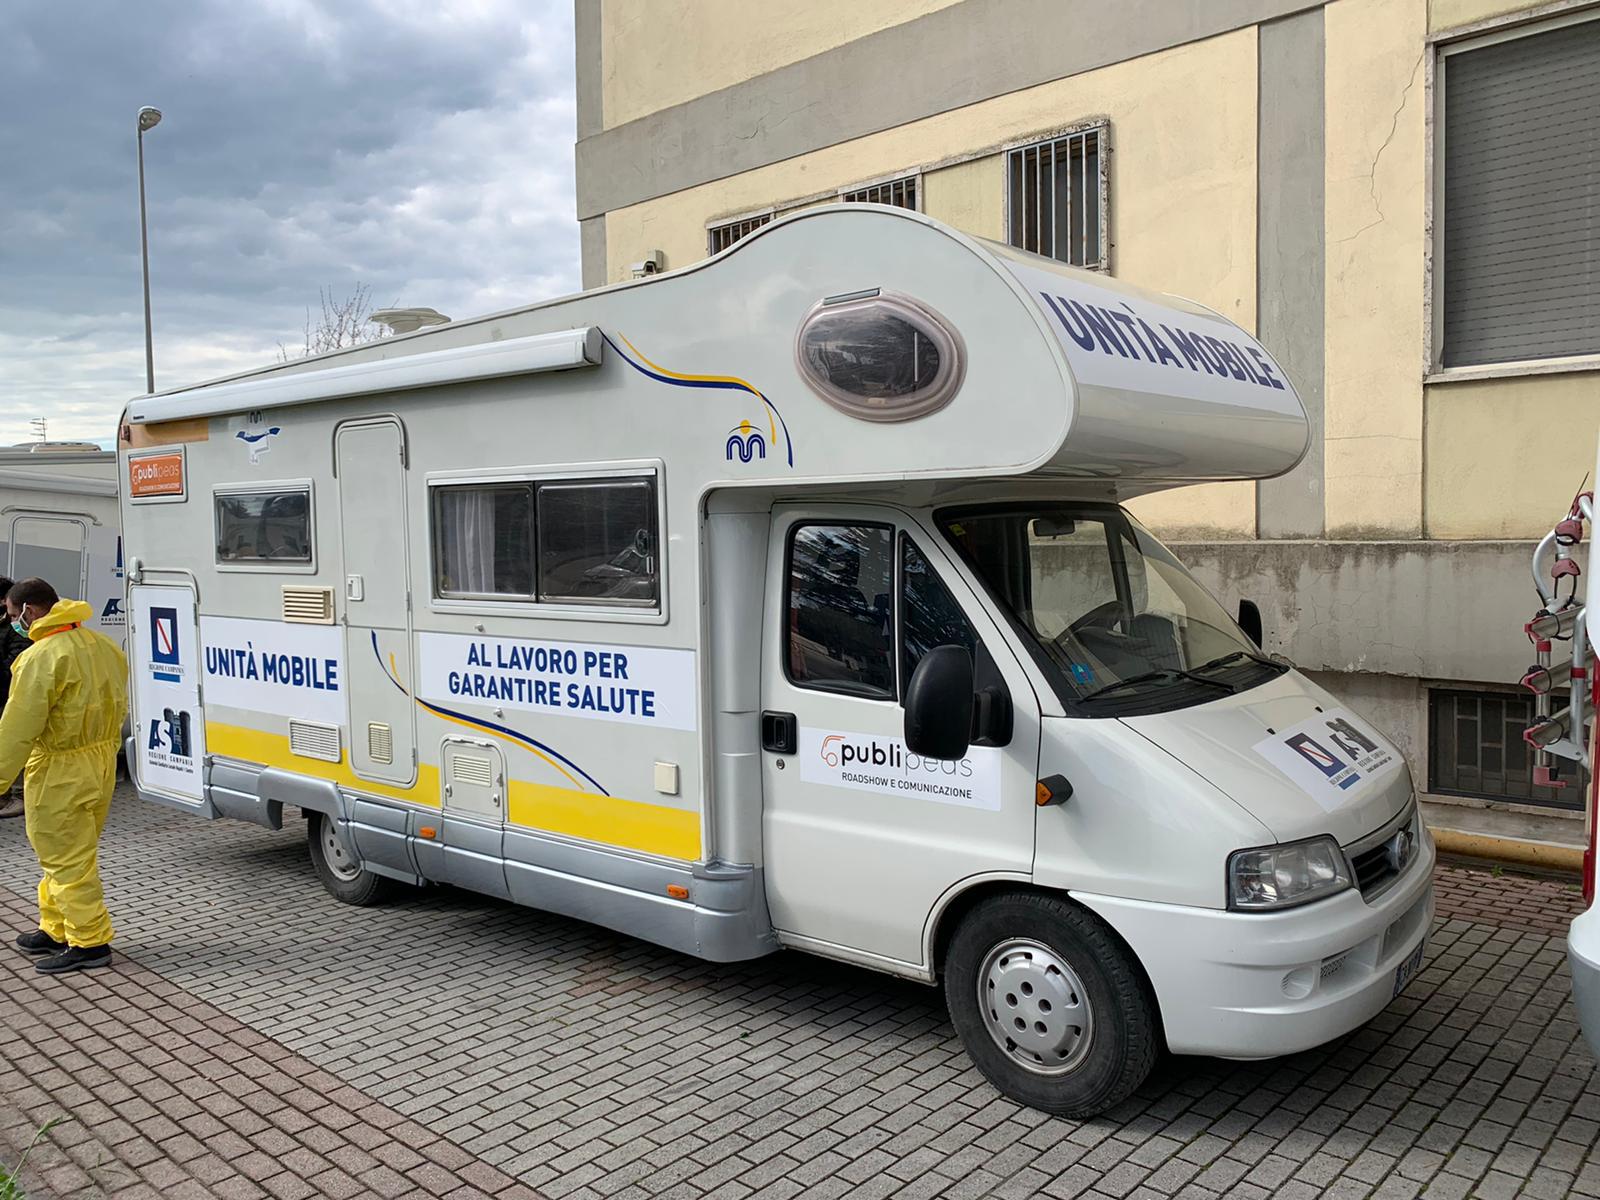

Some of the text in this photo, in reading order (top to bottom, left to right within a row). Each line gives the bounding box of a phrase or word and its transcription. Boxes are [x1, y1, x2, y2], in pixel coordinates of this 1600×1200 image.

[1039, 291, 1286, 391] UNITÀ MOBILE
[205, 641, 339, 691] UNITÀ MOBILE
[467, 643, 629, 680] AL LAVORO PER
[448, 671, 656, 718] GARANTIRE SALUTE
[841, 771, 973, 799] ROADSHOW E COMUNICAZIONE
